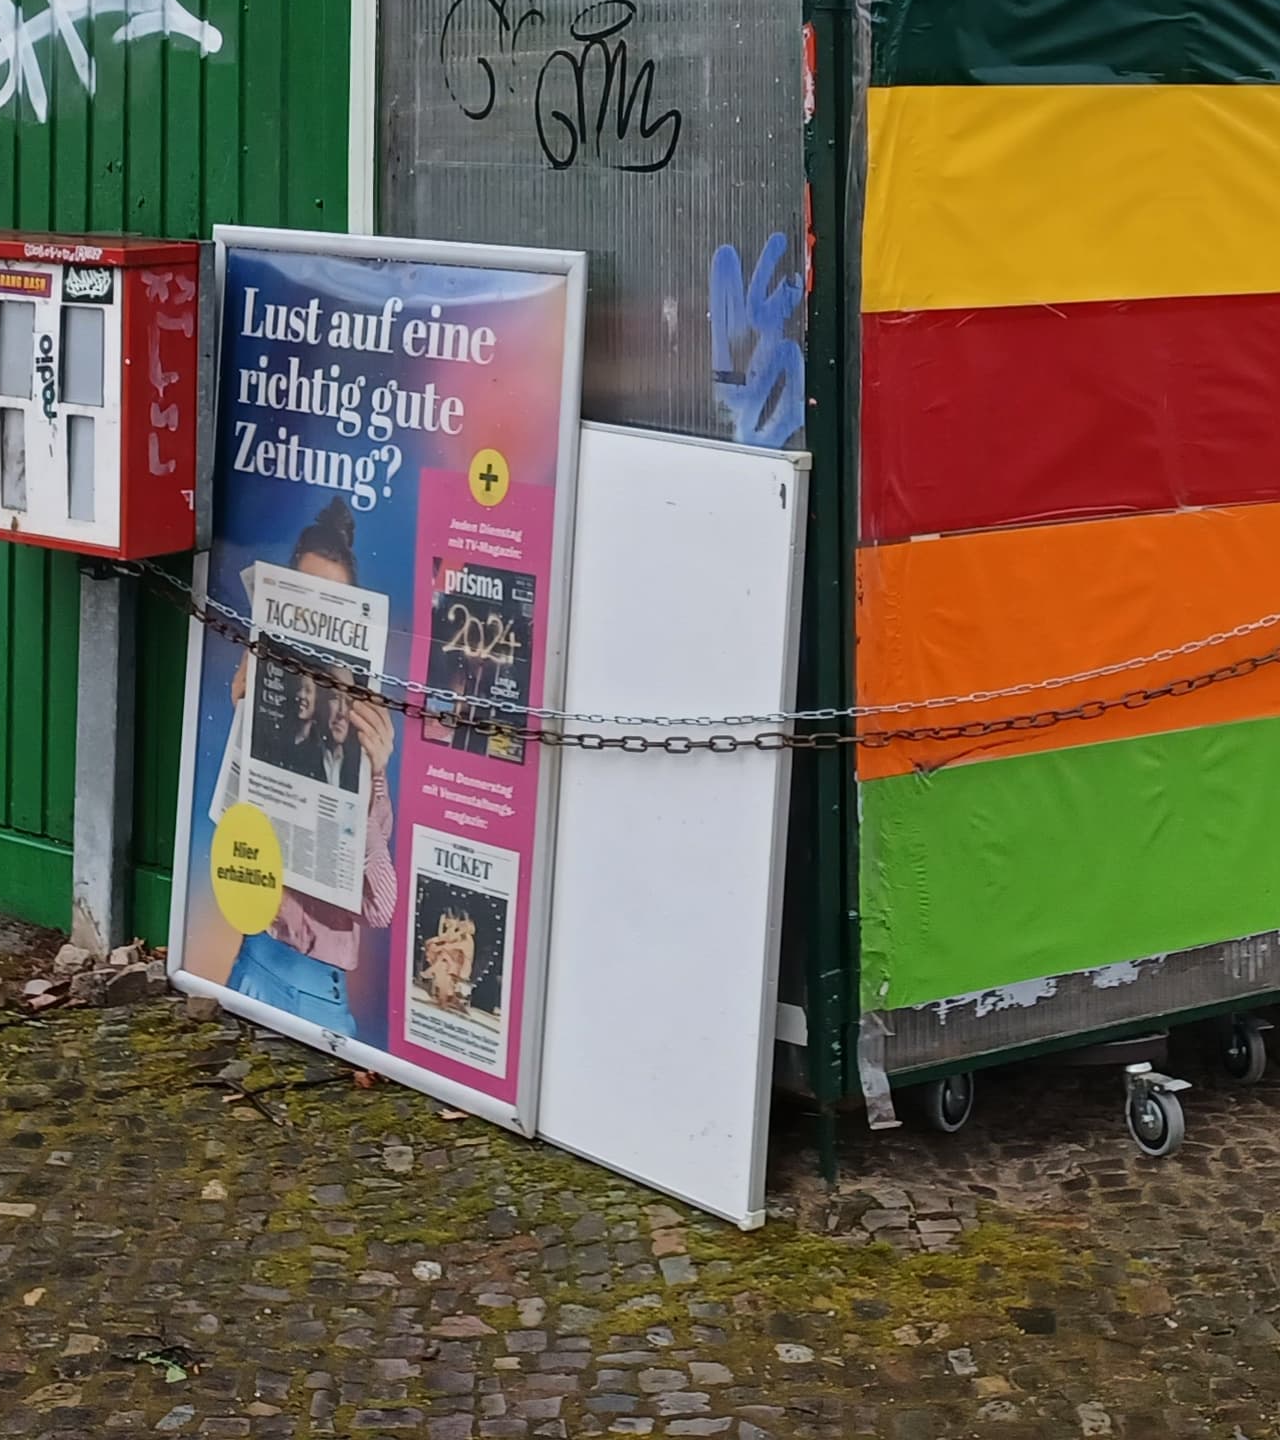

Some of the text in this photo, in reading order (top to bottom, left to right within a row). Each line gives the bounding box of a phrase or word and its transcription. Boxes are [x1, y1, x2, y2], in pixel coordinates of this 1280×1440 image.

[240, 286, 497, 366] Lust auf eine
[237, 355, 466, 443] richtig gute
[233, 420, 403, 512] Zeitung?
[444, 566, 503, 601] prisma
[265, 597, 369, 653] TAGESSPIEGEL
[422, 783, 439, 797] mit
[233, 841, 259, 860] Hier
[434, 847, 493, 881] TICKET
[217, 864, 276, 889] erhältlich
